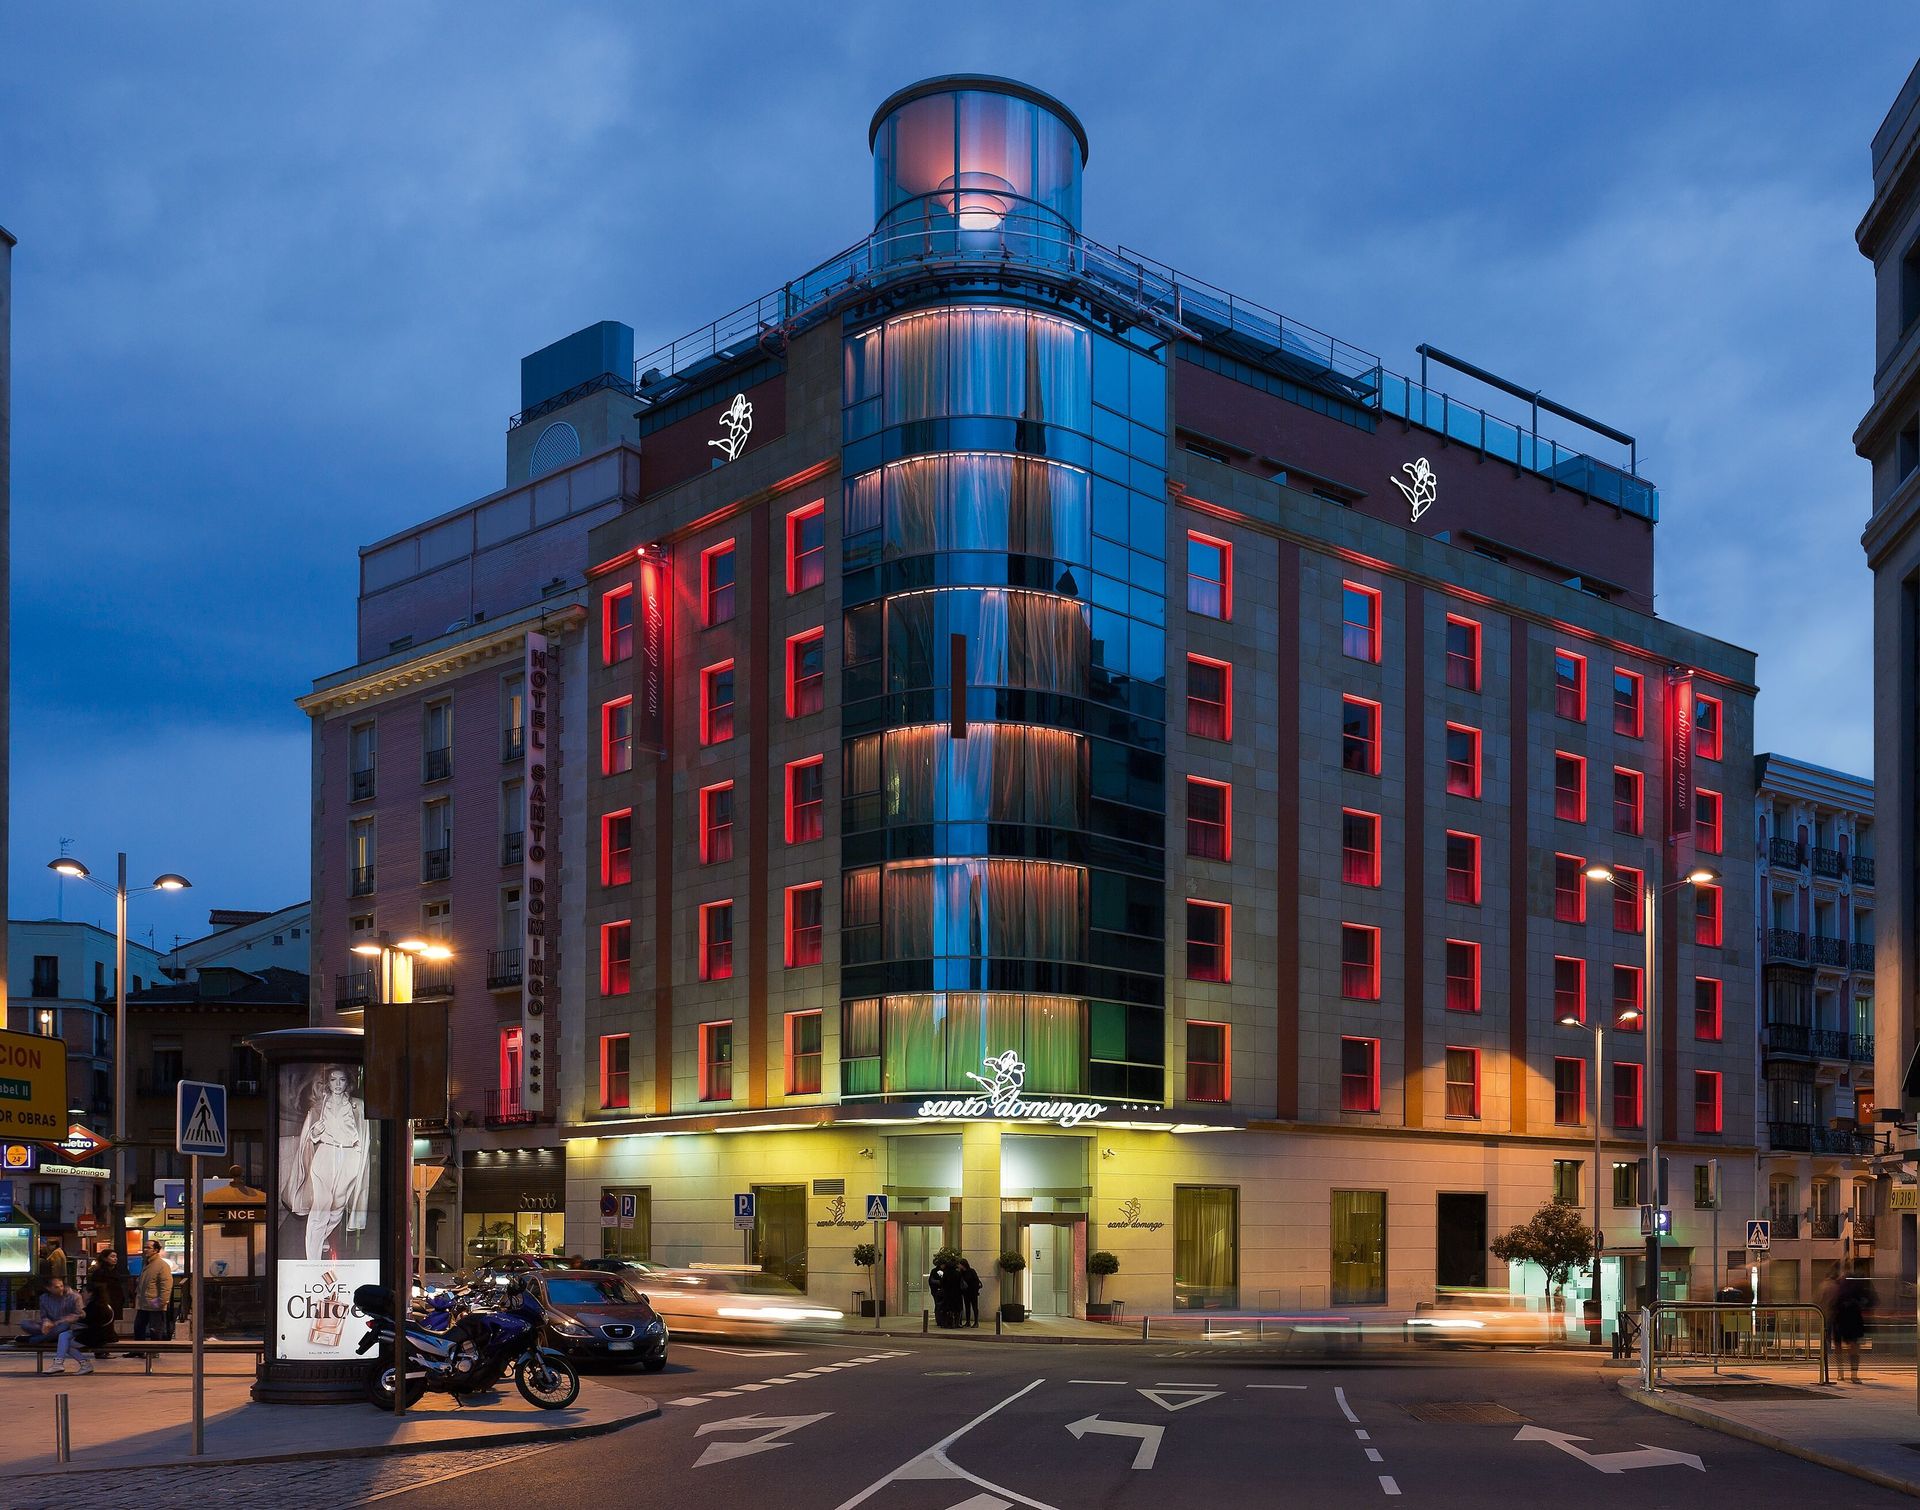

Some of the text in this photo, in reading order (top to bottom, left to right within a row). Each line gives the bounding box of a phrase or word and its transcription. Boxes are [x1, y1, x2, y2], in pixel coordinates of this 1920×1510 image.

[643, 593, 663, 718] santo domingo
[1673, 709, 1690, 810] santo domingo
[527, 648, 547, 1016] HOTEL SANTO DOMINGO
[918, 1090, 1107, 1127] santo domingo
[18, 1111, 57, 1127] OBRAS
[46, 1166, 105, 1177] Santo Domingo
[624, 1196, 631, 1215] P
[739, 1195, 748, 1215] P
[1107, 1218, 1164, 1232] santo domingo
[1654, 1213, 1666, 1229] P
